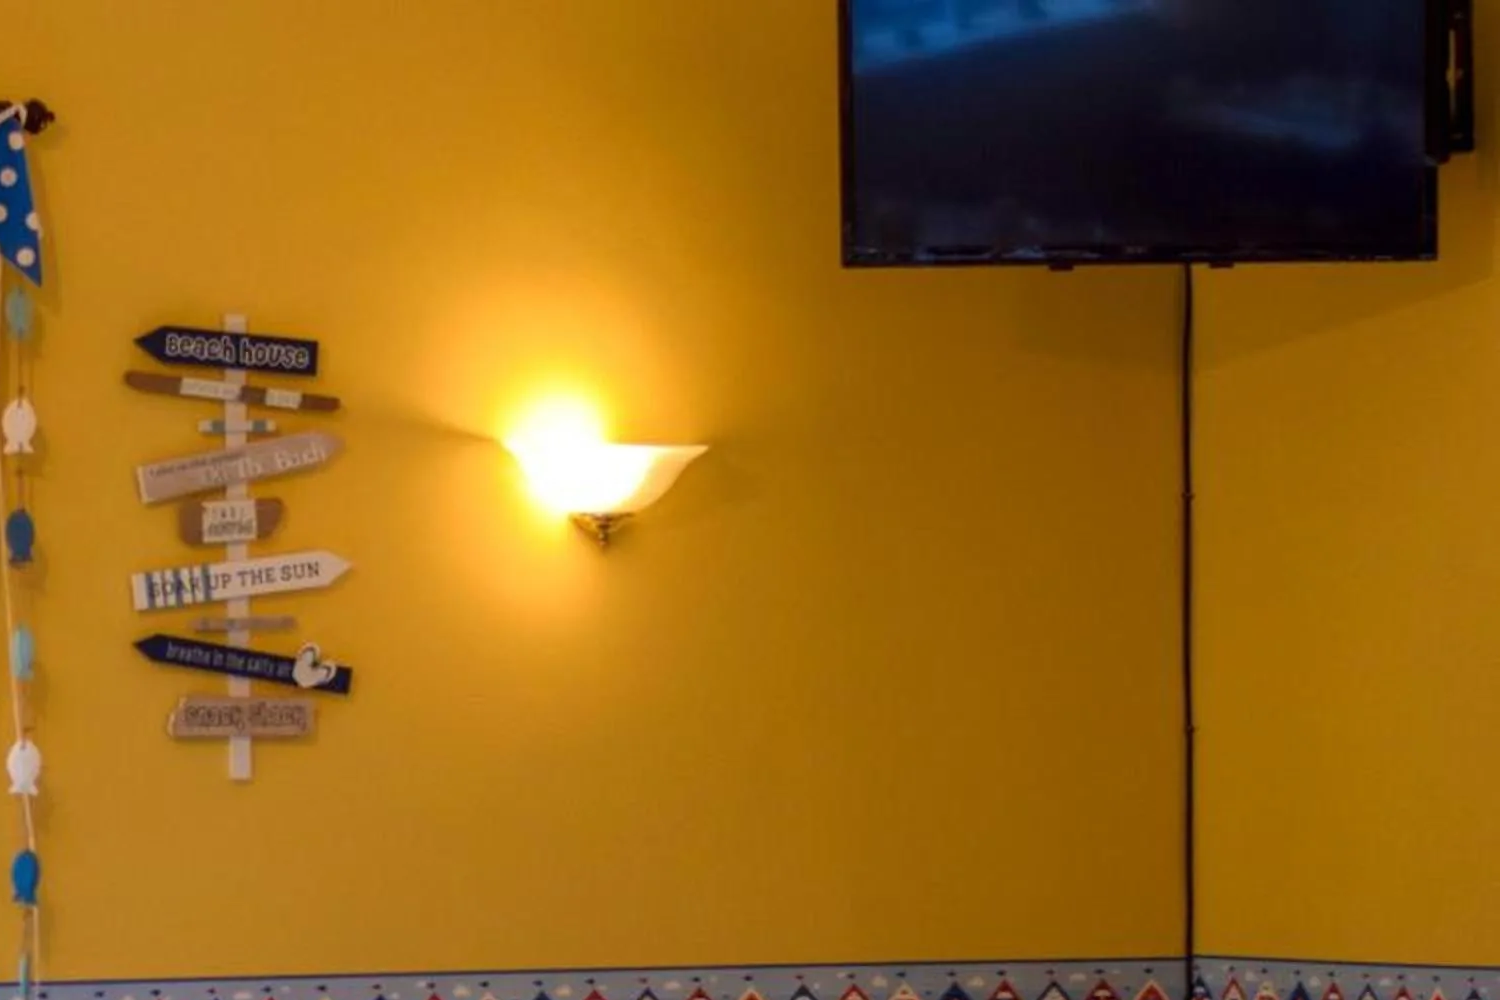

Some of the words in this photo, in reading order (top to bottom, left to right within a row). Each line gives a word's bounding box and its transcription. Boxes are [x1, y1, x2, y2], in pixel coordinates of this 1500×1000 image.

[165, 333, 236, 363] Beach
[206, 573, 232, 591] UP
[236, 567, 278, 586] THE
[280, 561, 322, 581] SUN
